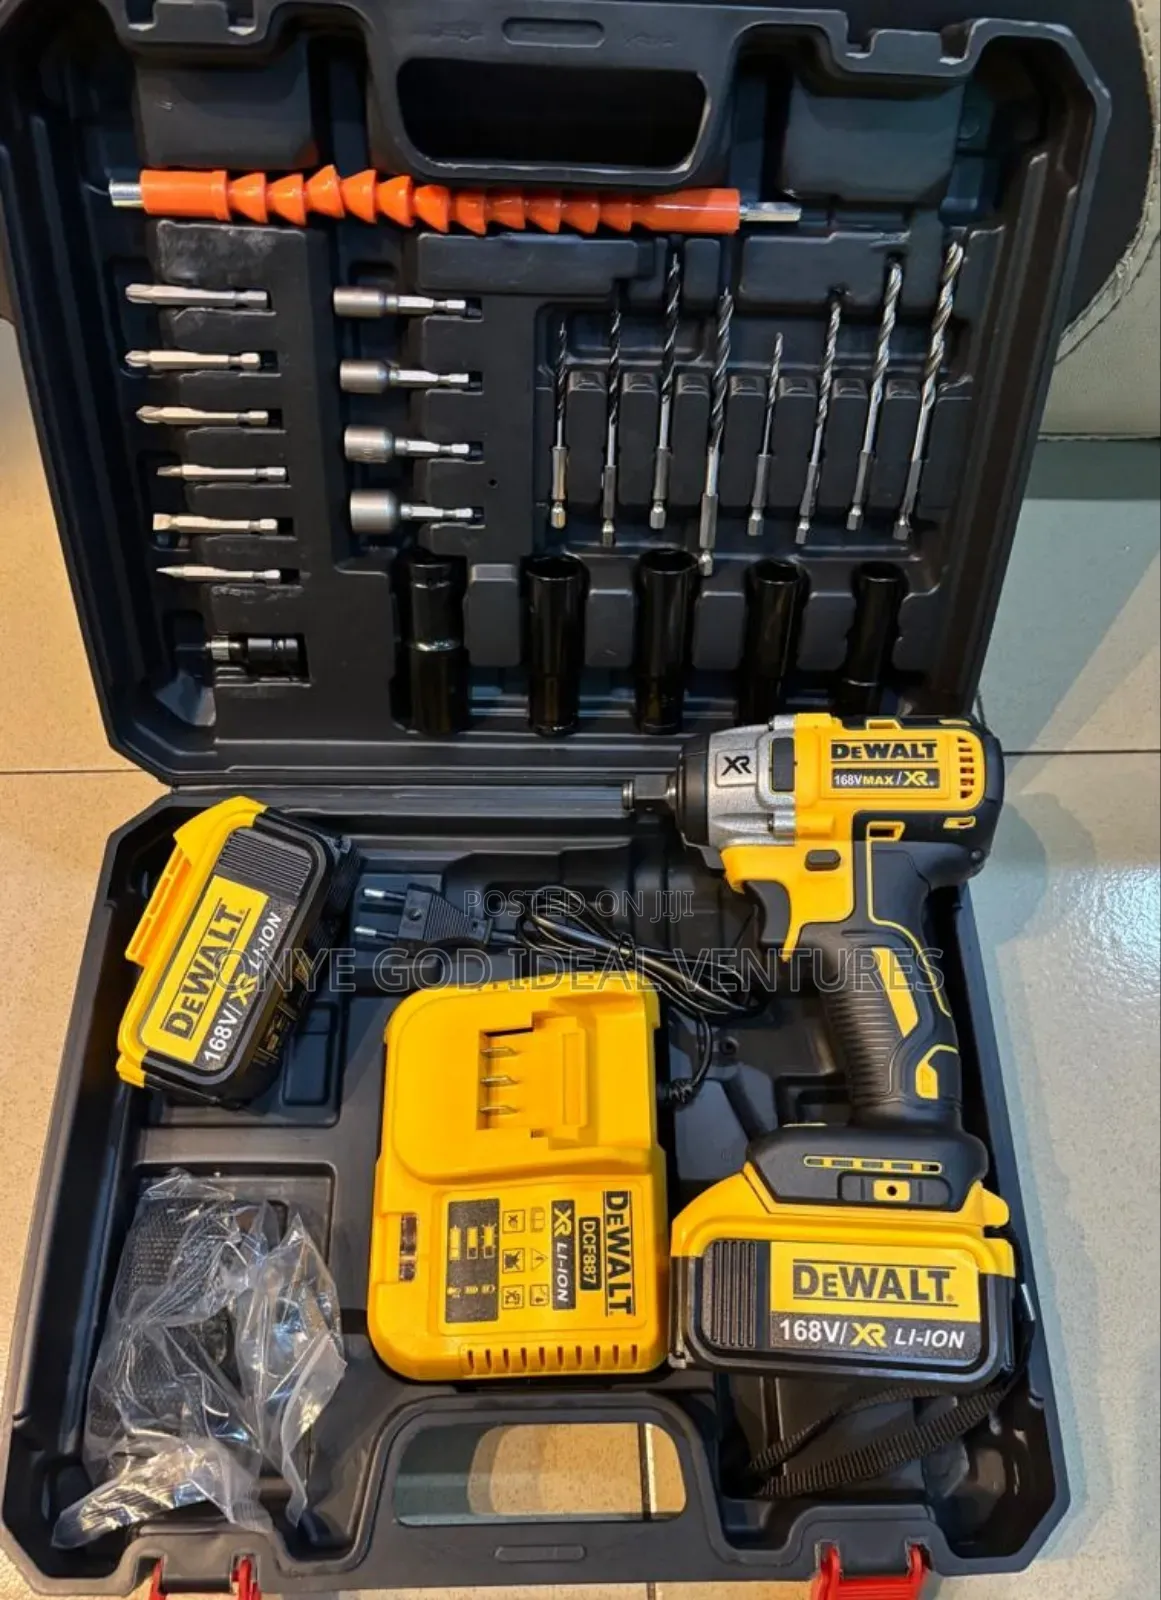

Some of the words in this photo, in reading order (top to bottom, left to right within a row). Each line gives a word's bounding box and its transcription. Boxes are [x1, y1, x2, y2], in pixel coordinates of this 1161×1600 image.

[721, 755, 752, 776] XR
[249, 911, 283, 970] LI-ION
[553, 1207, 572, 1238] XR
[556, 1242, 569, 1302] LI-ION
[582, 1220, 597, 1284] DCF887
[894, 1327, 965, 1349] LI-ION
